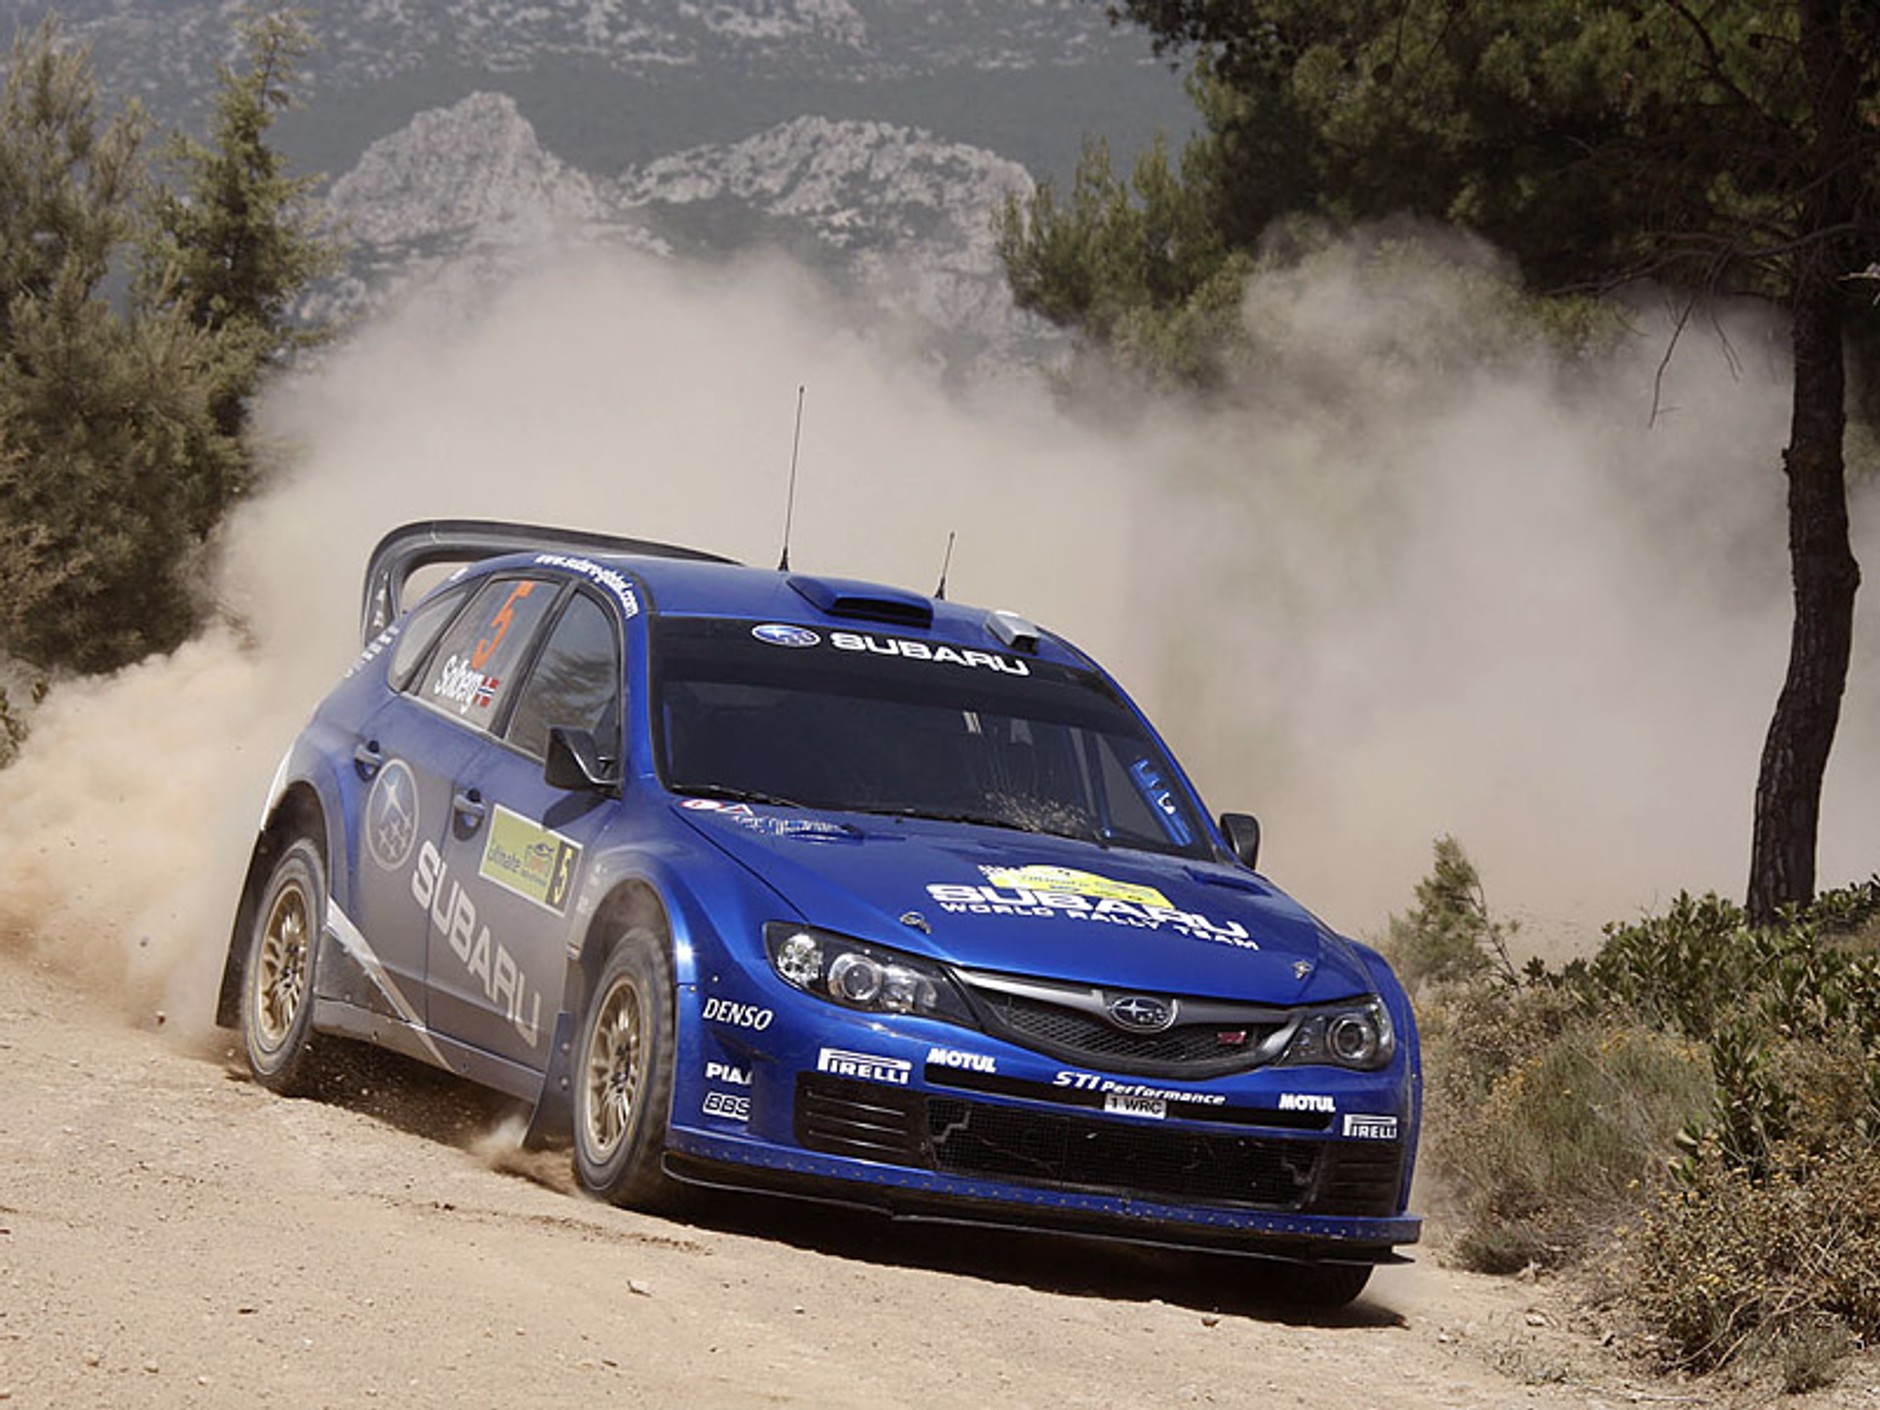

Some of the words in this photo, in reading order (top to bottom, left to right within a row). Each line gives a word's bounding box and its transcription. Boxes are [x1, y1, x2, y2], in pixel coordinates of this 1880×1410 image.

[472, 580, 536, 671] 5
[831, 632, 1029, 676] SUBARU
[434, 655, 481, 714] Solberg
[554, 847, 573, 904] 5
[926, 884, 1249, 940] SUBARU
[940, 902, 1054, 917] WORLD
[1067, 910, 1159, 930] RALLY
[1173, 924, 1259, 951] TEAM
[410, 840, 541, 1048] SUBARU
[702, 998, 774, 1031] DENSO
[817, 1048, 912, 1084] PIRELLI
[926, 1048, 997, 1073] MOTUL
[703, 1092, 750, 1121] BBS
[1053, 1071, 1101, 1091] STI
[1100, 1081, 1226, 1106] Performance
[1279, 1093, 1336, 1113] MOTUL
[1124, 1099, 1163, 1115] WRC
[1342, 1113, 1398, 1140] PIRELLI
